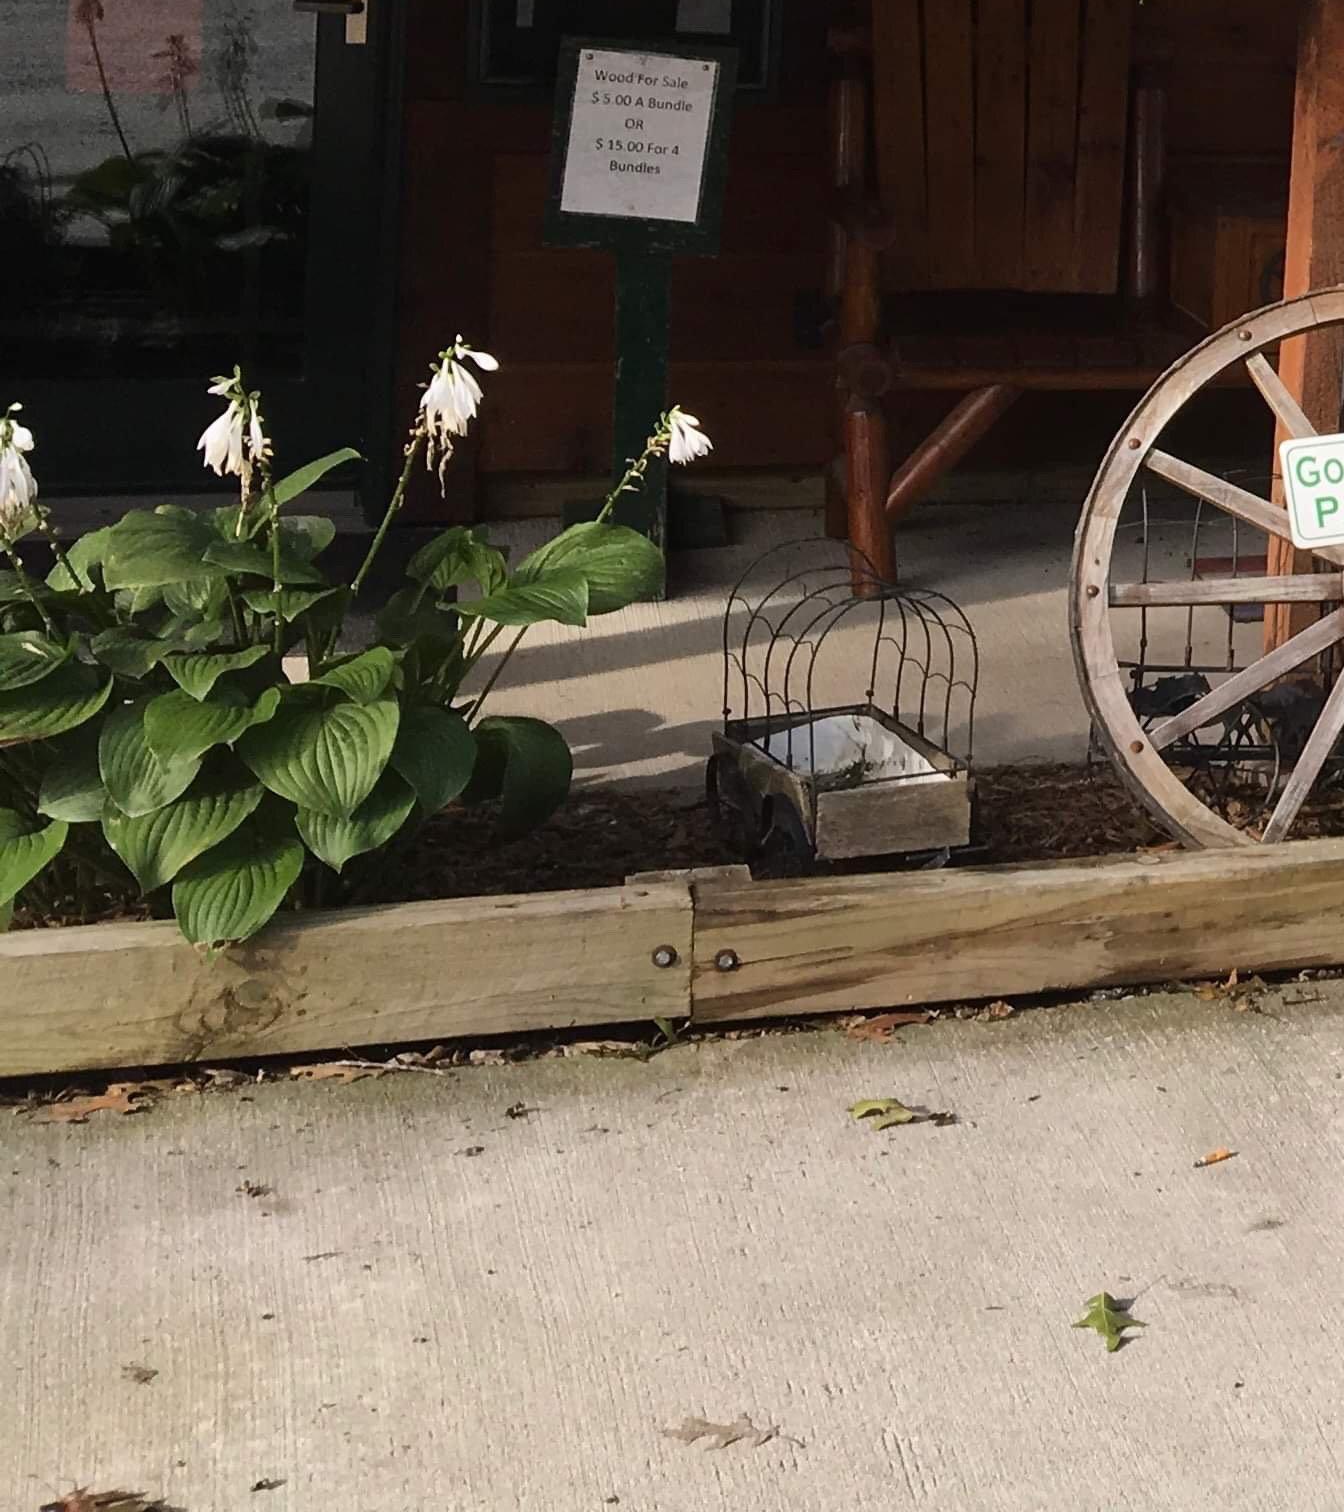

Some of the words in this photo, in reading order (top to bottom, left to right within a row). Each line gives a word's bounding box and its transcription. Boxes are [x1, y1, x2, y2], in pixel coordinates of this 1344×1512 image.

[594, 69, 634, 84] Wood
[637, 74, 658, 87] For
[663, 76, 689, 89] Sale
[634, 96, 644, 108] A
[648, 98, 693, 113] Bundle
[624, 118, 644, 130] OR
[647, 142, 668, 155] For
[671, 145, 680, 156] 4
[609, 160, 661, 175] Bundles
